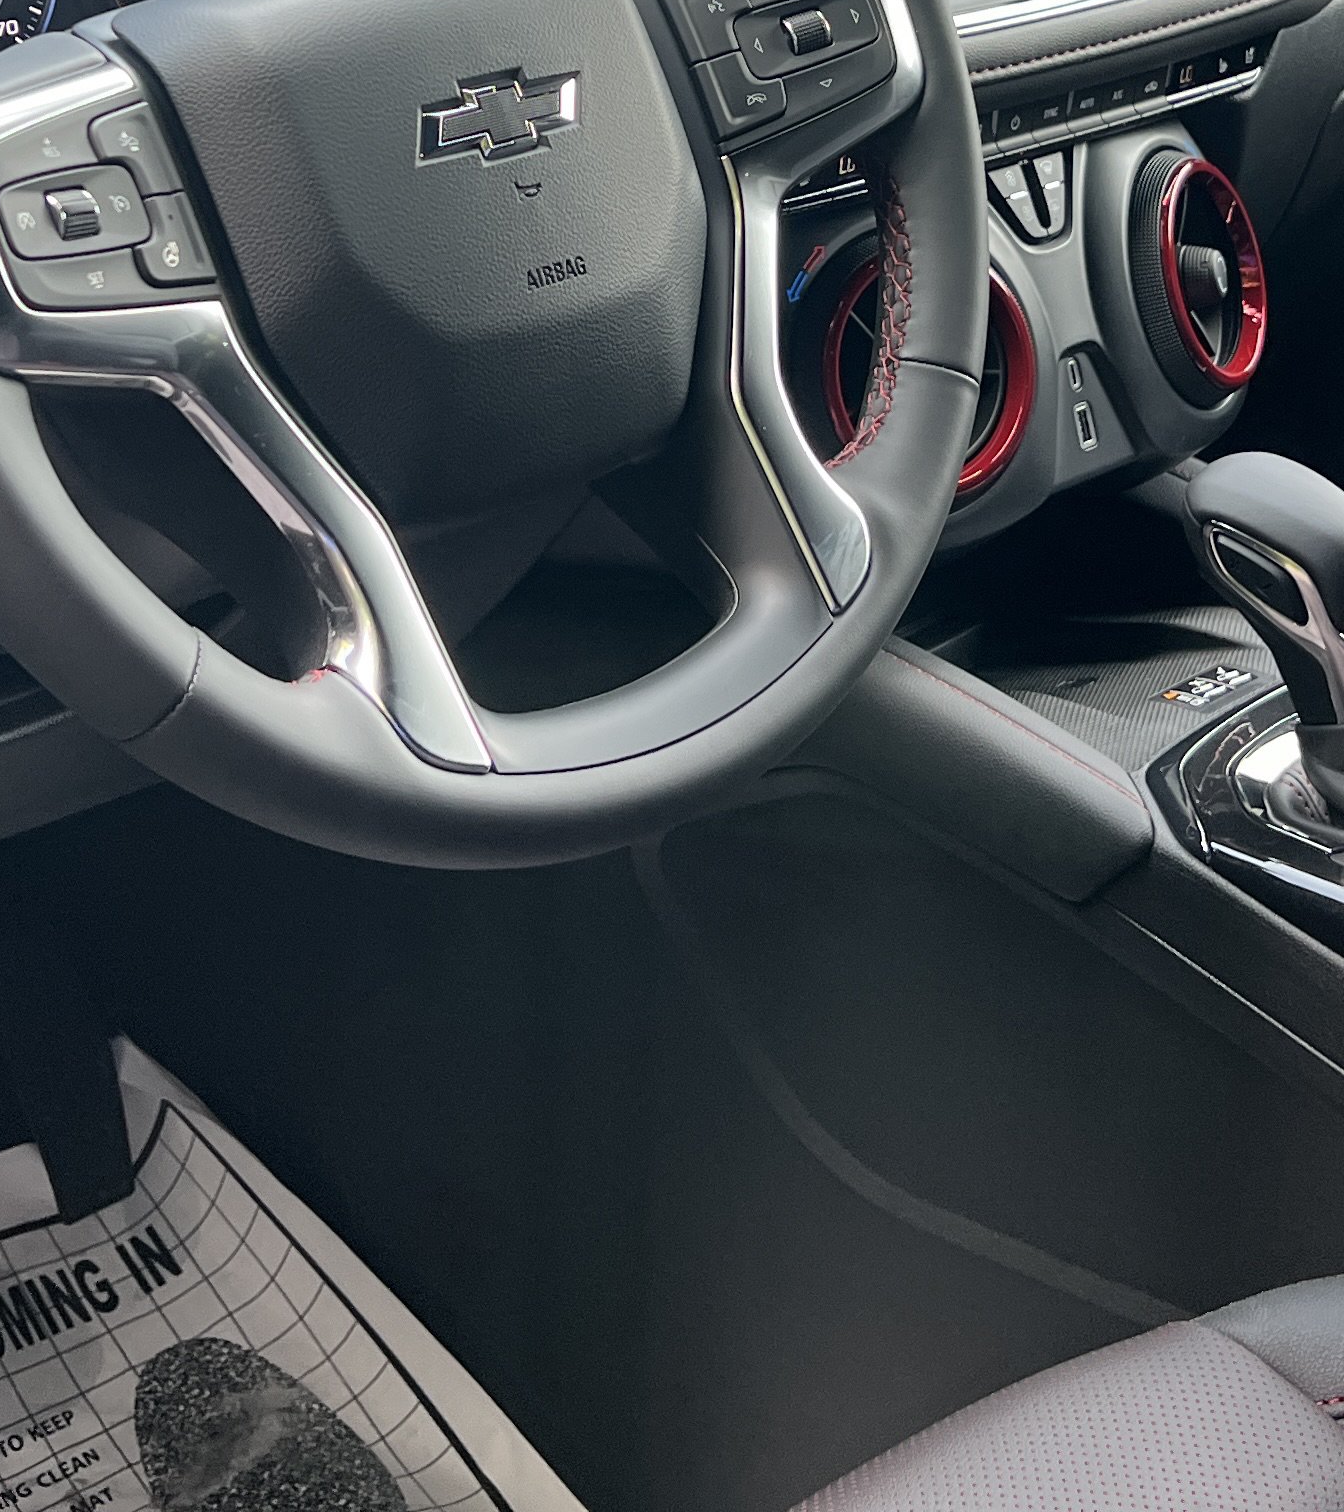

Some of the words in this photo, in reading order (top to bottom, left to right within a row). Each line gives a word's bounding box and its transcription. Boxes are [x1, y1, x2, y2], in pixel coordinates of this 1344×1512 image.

[527, 256, 587, 289] AIRBAG
[115, 1226, 182, 1294] IN
[27, 1409, 75, 1442] KEEP
[36, 1448, 100, 1488] CLEAN
